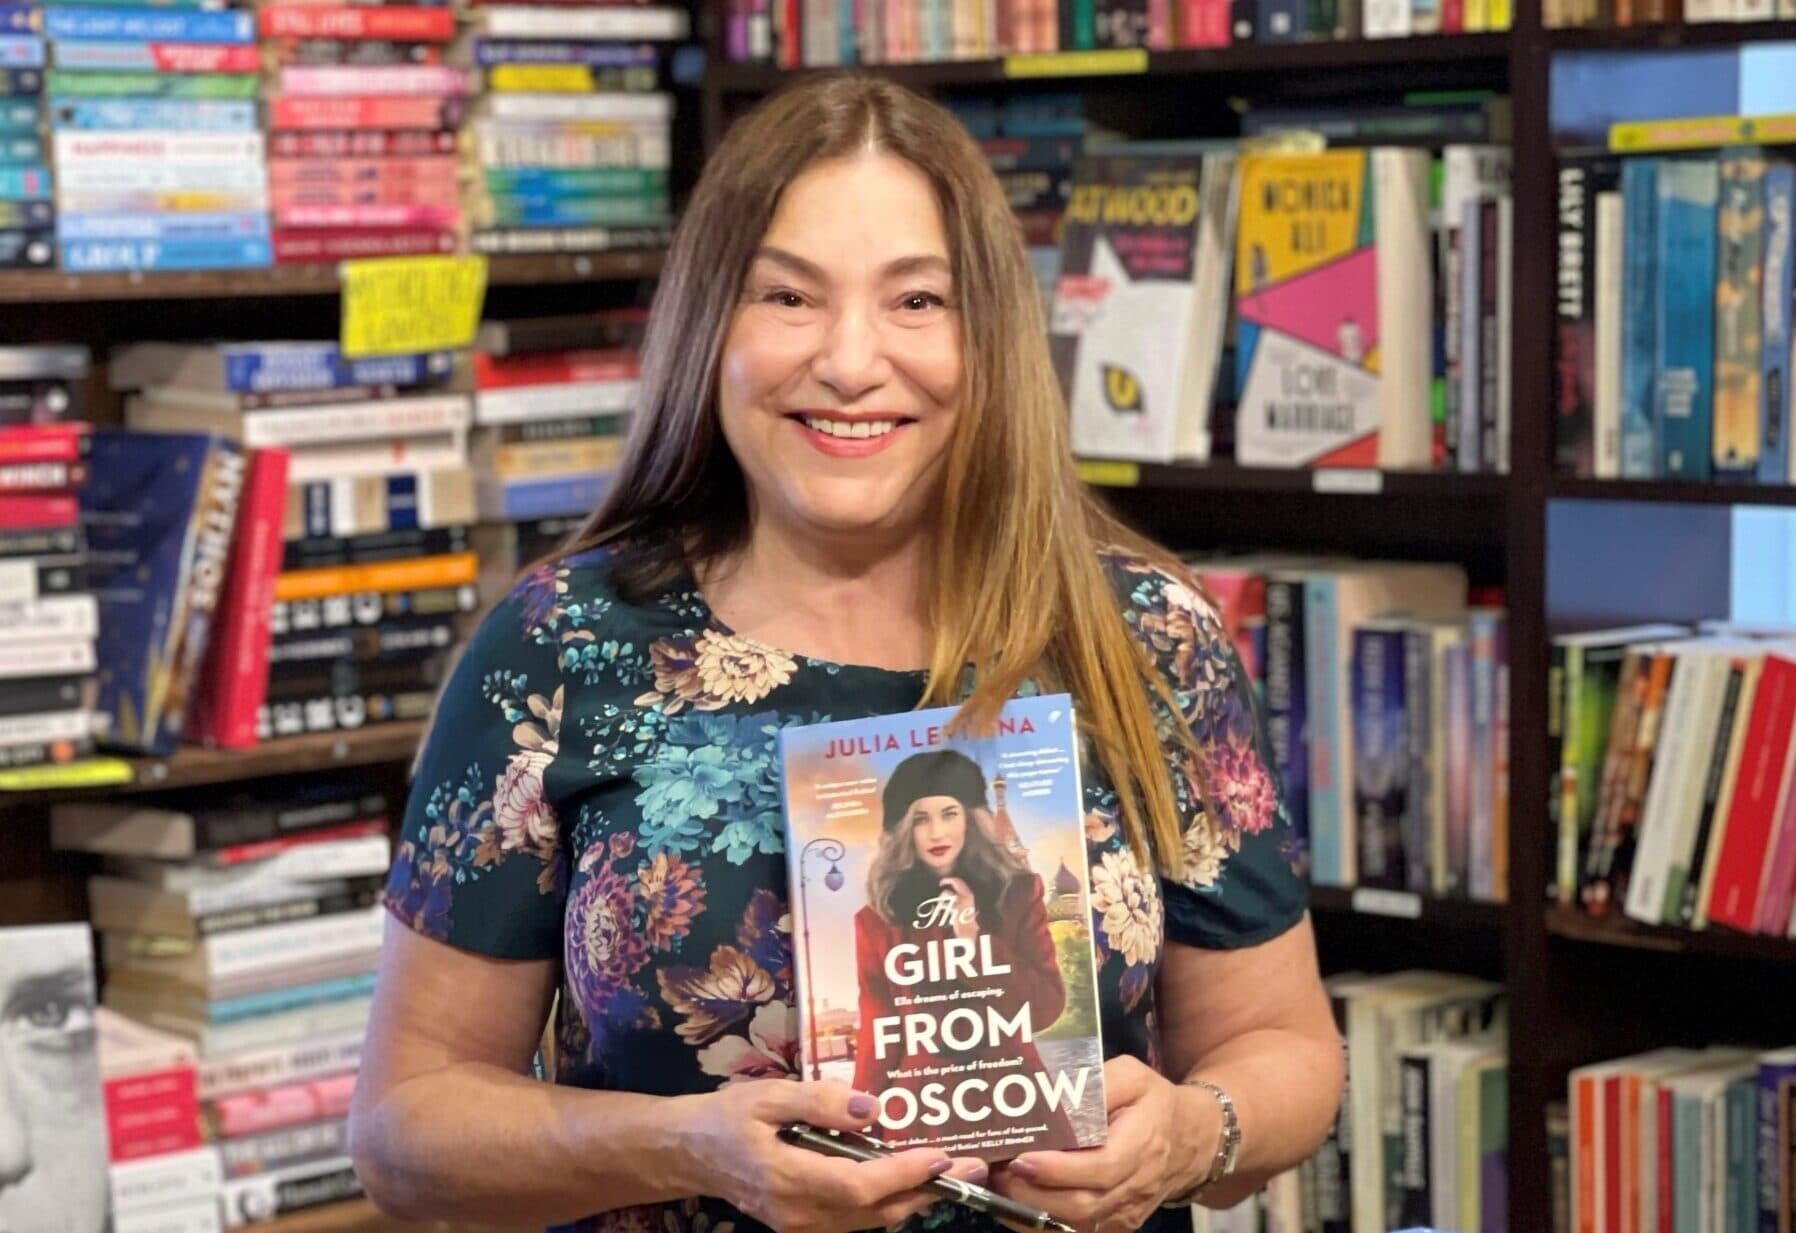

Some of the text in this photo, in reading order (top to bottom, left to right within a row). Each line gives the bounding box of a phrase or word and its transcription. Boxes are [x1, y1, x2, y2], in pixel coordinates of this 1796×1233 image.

[1066, 183, 1198, 226] ATWOOD
[1263, 179, 1352, 213] MONICA
[1290, 219, 1327, 253] ALI
[1556, 168, 1585, 318] LILY BRETT
[1265, 401, 1356, 431] MARRIAGE
[825, 717, 1035, 759] JULIA LENA
[912, 893, 977, 930] The
[884, 934, 1011, 986] GIRL
[949, 989, 959, 1000] of
[873, 1001, 1033, 1060] FROM
[887, 1056, 1024, 1079] What is the price of freedom?
[858, 1066, 1091, 1133] OSCOW
